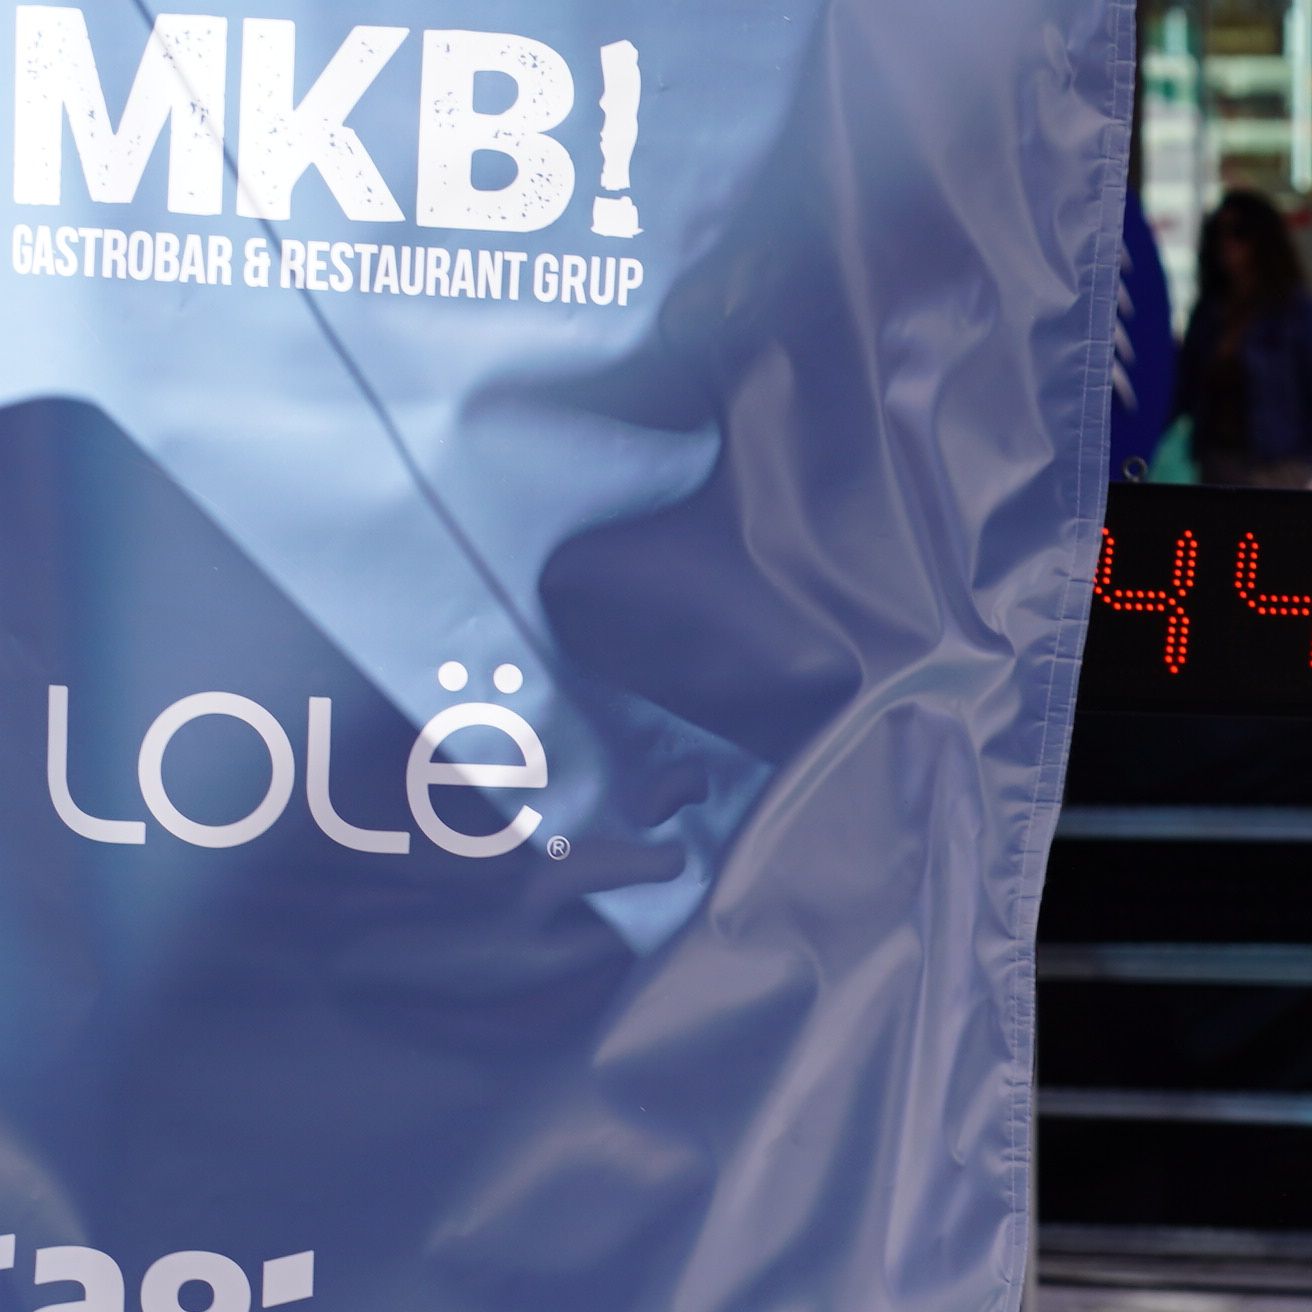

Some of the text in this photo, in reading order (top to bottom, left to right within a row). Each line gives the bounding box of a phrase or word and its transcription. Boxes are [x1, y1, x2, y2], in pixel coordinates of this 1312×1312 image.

[13, 5, 642, 239] MKB!
[11, 223, 644, 307] GASTROBAR & RESTAURANT GRUP
